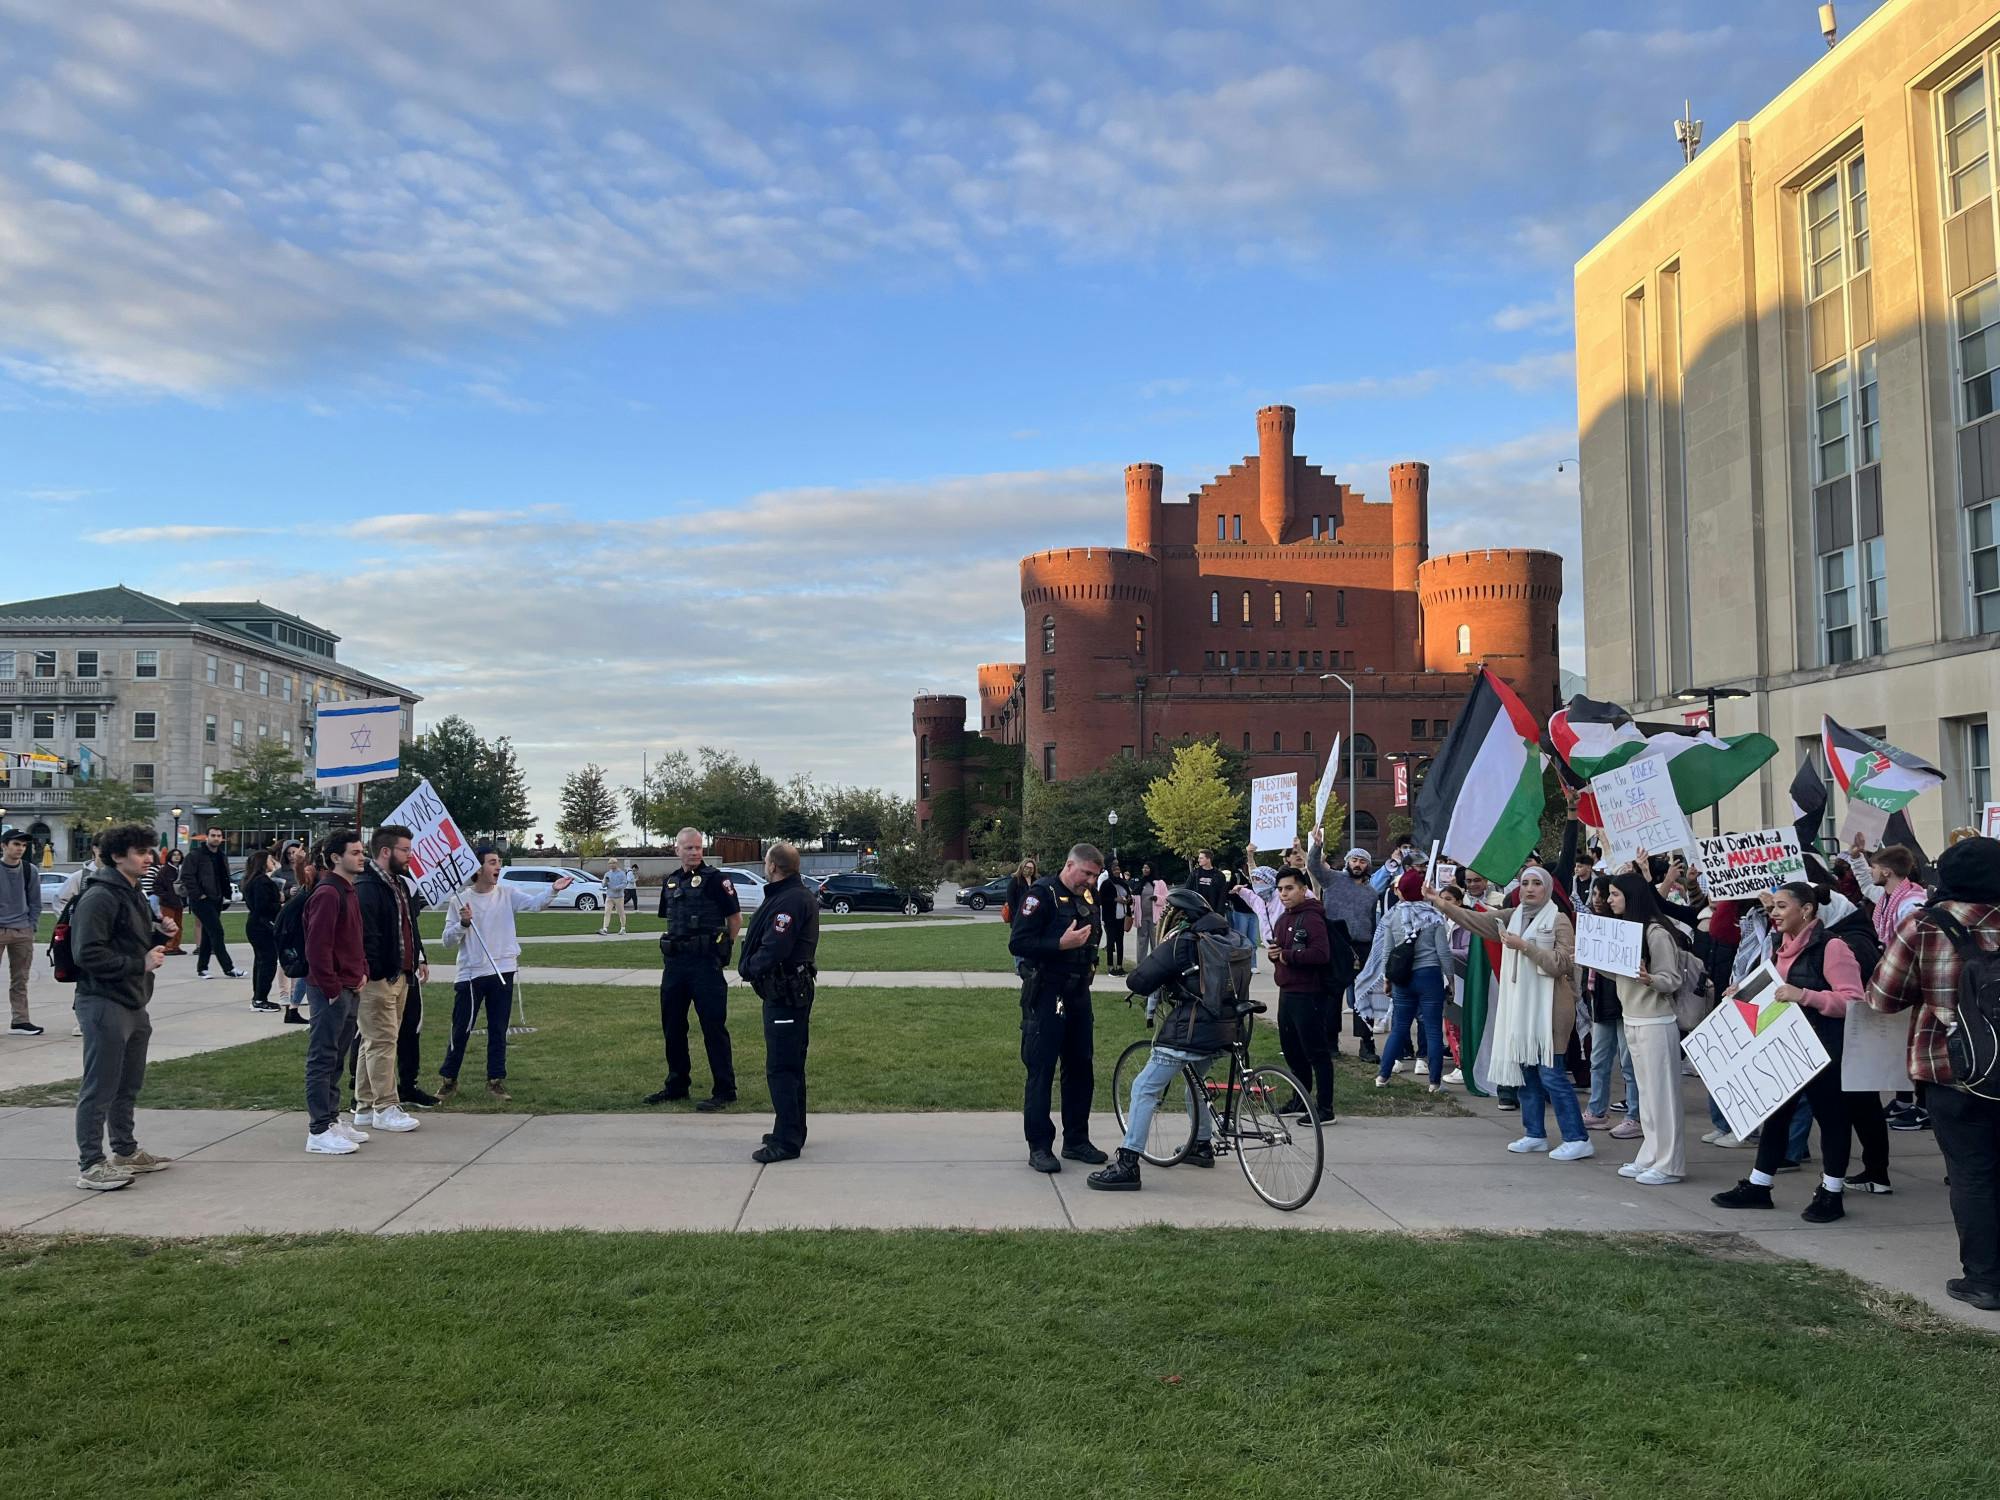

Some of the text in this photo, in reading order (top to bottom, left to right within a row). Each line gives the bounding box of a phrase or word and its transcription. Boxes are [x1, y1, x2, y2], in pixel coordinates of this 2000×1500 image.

[1630, 759, 1658, 780] RIVER
[1397, 766, 1408, 804] 175
[1624, 786, 1645, 803] SEA
[394, 786, 443, 832] AMAS
[1256, 815, 1287, 831] RESIST
[1258, 801, 1294, 817] RIGHT TO
[1608, 798, 1659, 831] PALESTINE
[1636, 818, 1678, 848] FREE
[412, 829, 453, 874] KILLS
[1699, 839, 1725, 857] YOU
[1727, 846, 1785, 868] MUSLIM
[1784, 844, 1799, 858] TO
[420, 848, 475, 906] BABIES
[1737, 865, 1750, 878] UP
[1768, 858, 1804, 875] GAZA
[1578, 914, 1626, 943] END ALL US
[1591, 938, 1604, 962] TO
[1684, 1003, 1752, 1082] FREE
[1714, 1020, 1827, 1136] PALESTINE
